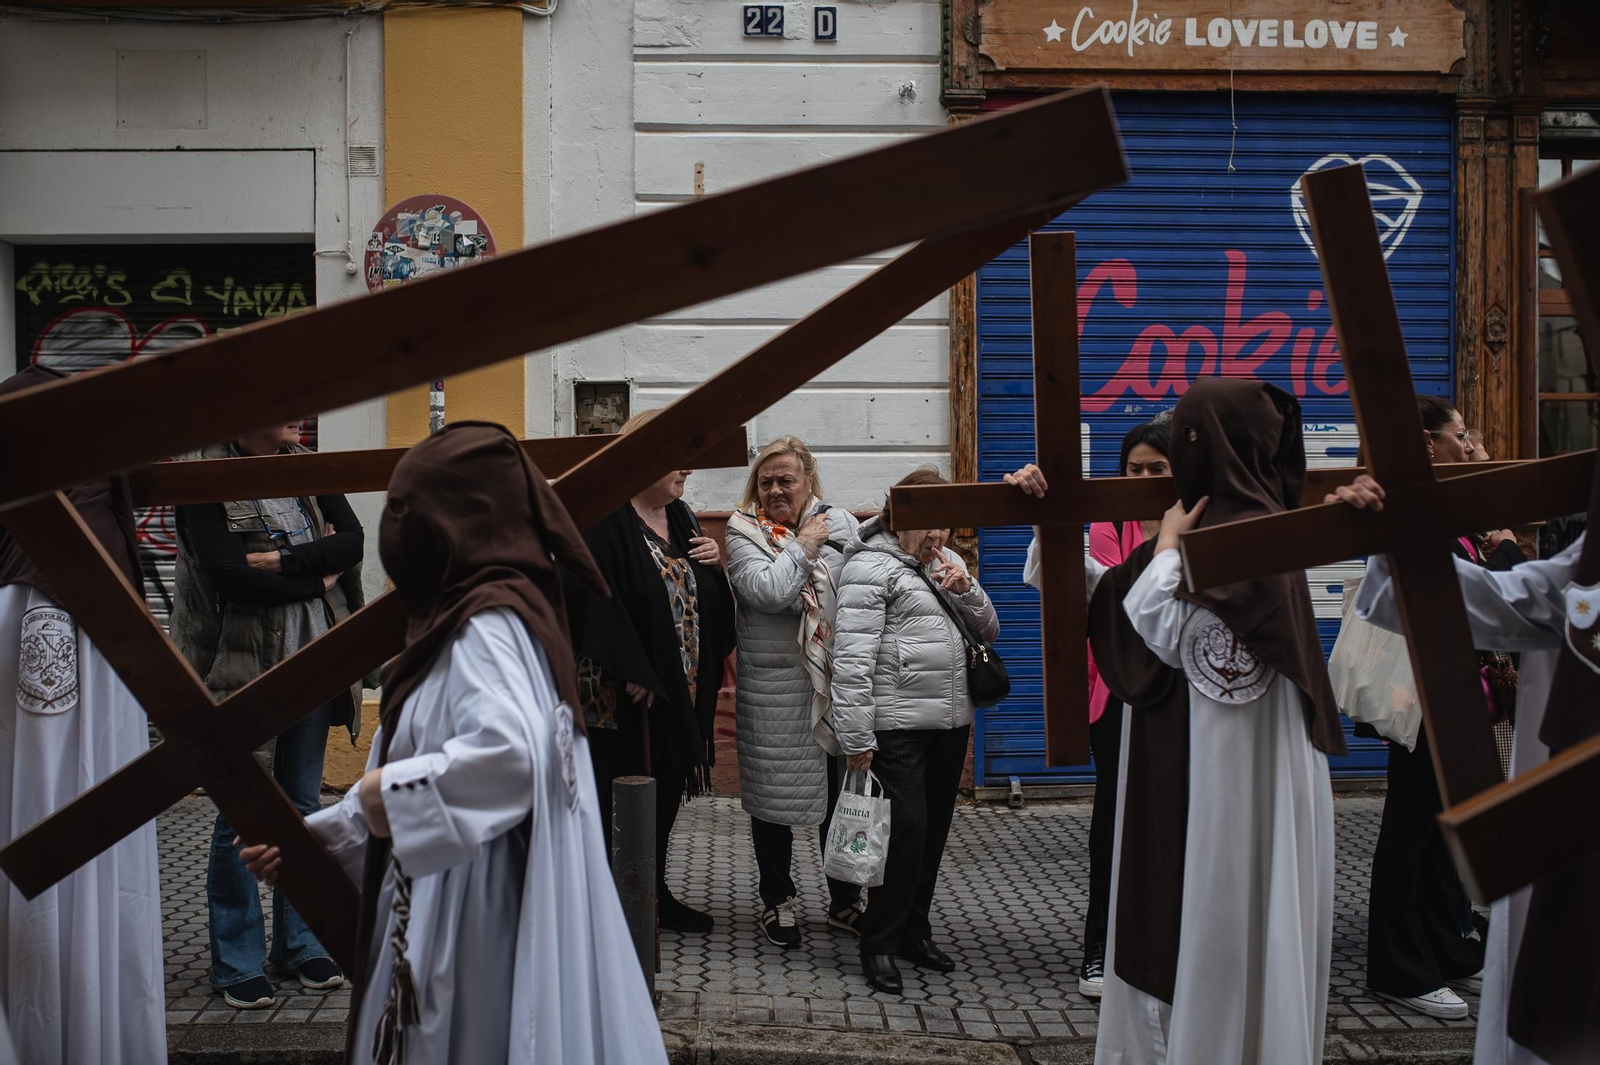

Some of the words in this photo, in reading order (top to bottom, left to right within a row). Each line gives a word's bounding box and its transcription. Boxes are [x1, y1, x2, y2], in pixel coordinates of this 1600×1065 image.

[746, 7, 782, 34] 22
[817, 10, 834, 36] D
[1071, 0, 1172, 57] Cookie
[1185, 17, 1378, 50] LOVELOVE
